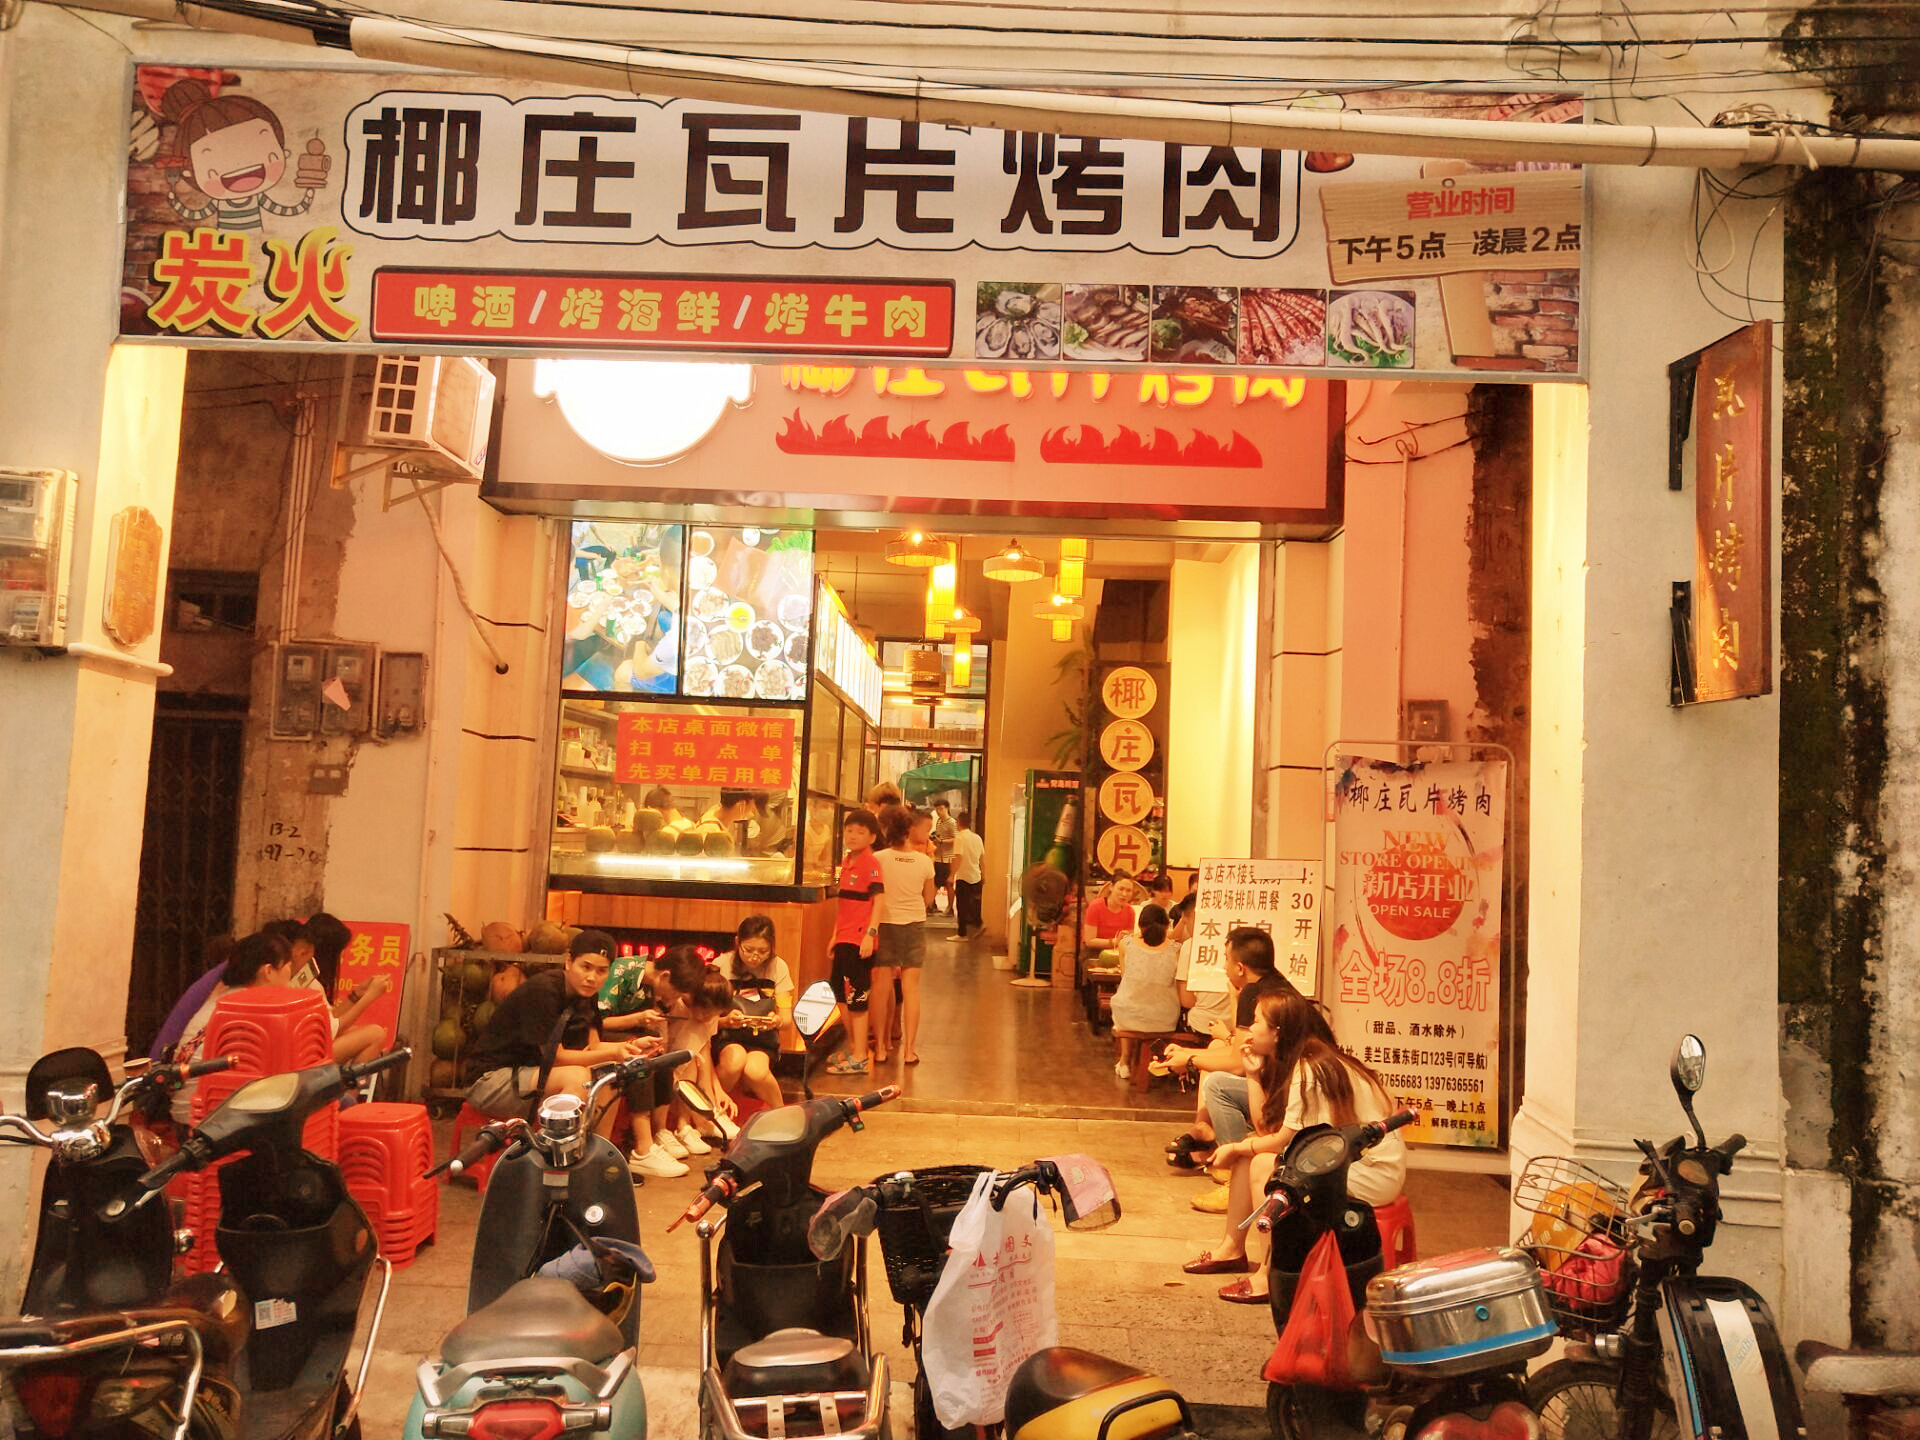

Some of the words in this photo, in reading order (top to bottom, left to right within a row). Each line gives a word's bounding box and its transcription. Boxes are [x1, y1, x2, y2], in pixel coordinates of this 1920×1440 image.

[359, 107, 1281, 242] 椰庄瓦片烤肉
[1405, 187, 1516, 221] 营业时间
[150, 226, 362, 341] 炭火
[414, 285, 927, 338] 啤酒/烤海鲜/烤牛肉
[631, 717, 785, 739] 本店桌面微信
[629, 739, 784, 763] 扫码点单
[628, 764, 784, 786] 先买单后用餐
[1109, 676, 1147, 872] 椰庄瓦片
[1348, 777, 1493, 817] 椰庄瓦片烤肉
[1382, 829, 1449, 852] NEW
[1340, 850, 1402, 868] STORE
[1360, 870, 1475, 903] 新店开业
[1200, 889, 1281, 912] 按现场排队用餐
[1291, 892, 1314, 910] 30
[1370, 903, 1410, 918] OPEN
[1414, 905, 1452, 919] SALE
[1294, 918, 1313, 940] 开
[341, 932, 401, 968] 务员
[1288, 952, 1309, 977] 始
[1339, 949, 1491, 1012] 全场8.8折
[1377, 1072, 1423, 1090] 37656683
[1425, 1076, 1485, 1093] 13976365561
